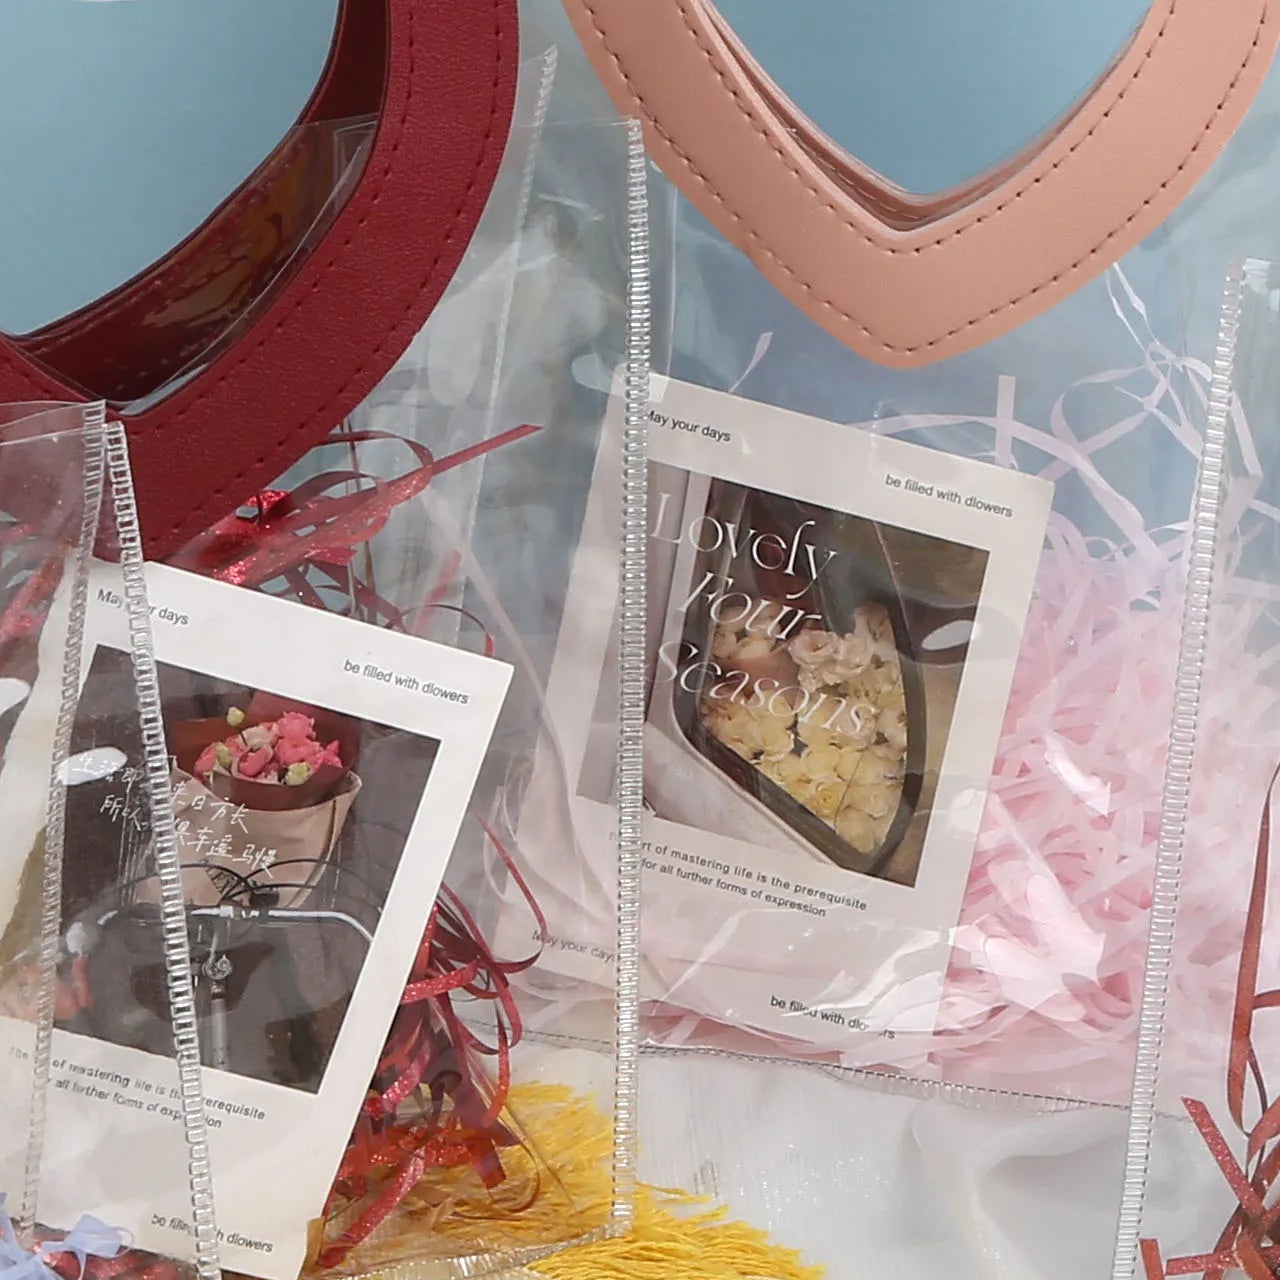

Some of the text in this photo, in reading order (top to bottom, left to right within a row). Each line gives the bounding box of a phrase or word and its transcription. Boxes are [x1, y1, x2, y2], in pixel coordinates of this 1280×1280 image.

[670, 418, 699, 432] your
[701, 425, 731, 442] days
[885, 474, 1013, 518] be filled with dlowers
[649, 493, 837, 600] Lovely
[158, 607, 190, 626] days
[678, 571, 822, 641] Four
[344, 659, 469, 705] be filled with dlowers
[644, 640, 876, 736] Seasons
[641, 857, 826, 918] for all further forms of expression
[655, 845, 668, 856] of
[670, 850, 731, 875] mastering
[734, 865, 753, 880] life
[757, 871, 767, 884] is
[771, 877, 790, 891] the
[794, 883, 867, 912] prerequisite
[770, 995, 786, 1009] be
[820, 1011, 845, 1025] with
[52, 1058, 66, 1070] of
[155, 1084, 167, 1096] is
[54, 1078, 71, 1090] all
[146, 1102, 159, 1113] of
